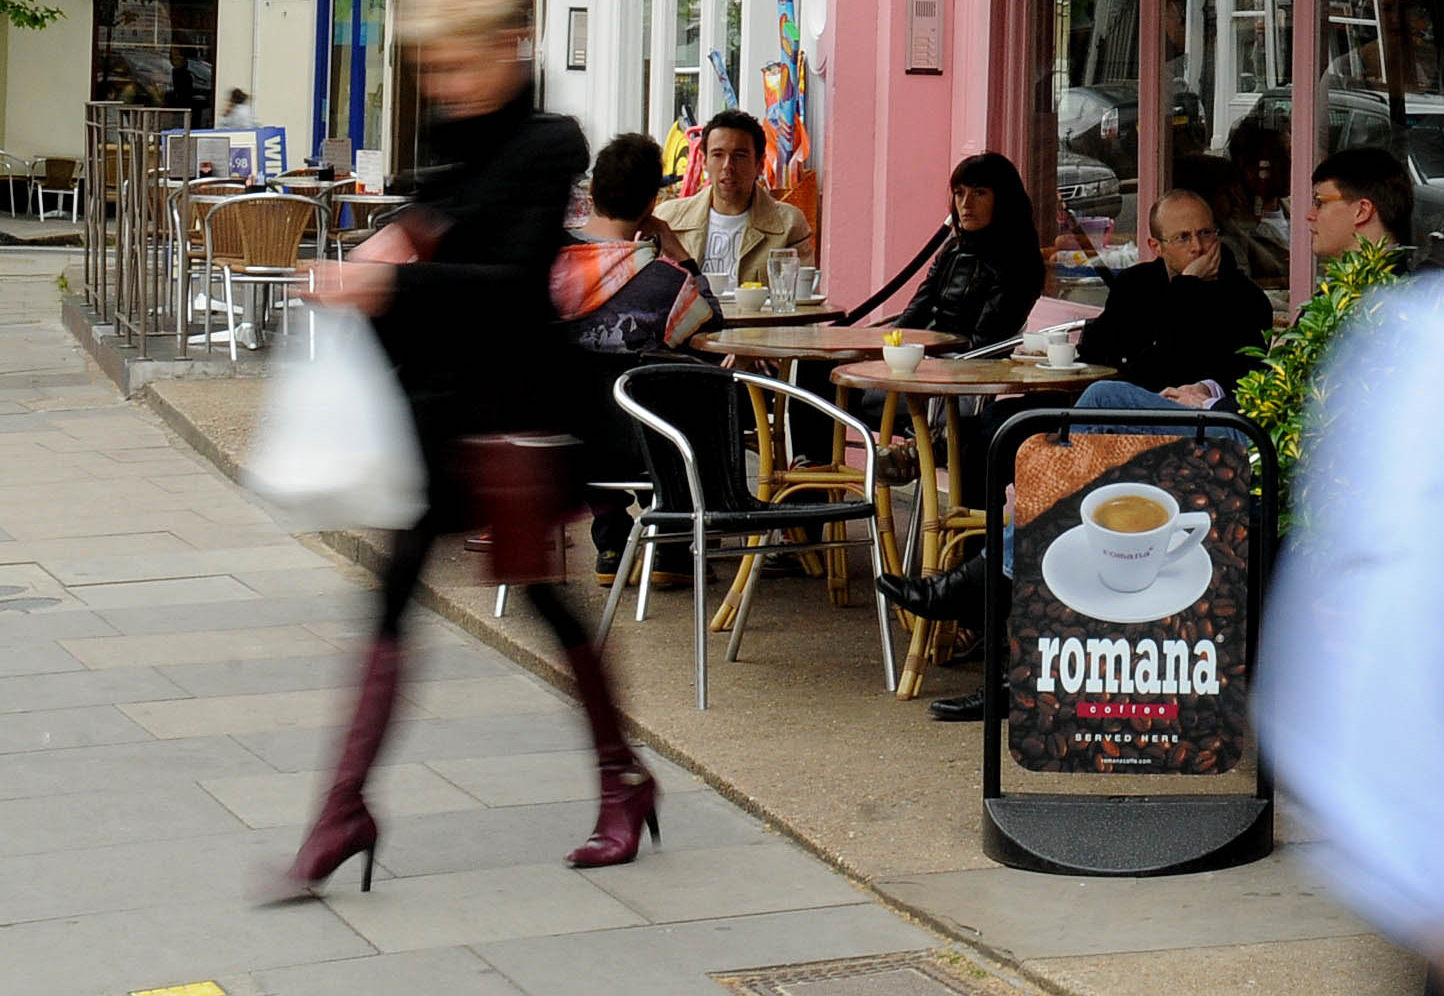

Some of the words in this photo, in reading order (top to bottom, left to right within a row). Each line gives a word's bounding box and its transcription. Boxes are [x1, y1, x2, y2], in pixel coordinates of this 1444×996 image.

[1036, 636, 1220, 696] romana
[1090, 705, 1165, 715] coffee
[1075, 733, 1132, 743] SERVED
[1141, 734, 1179, 744] HERE
